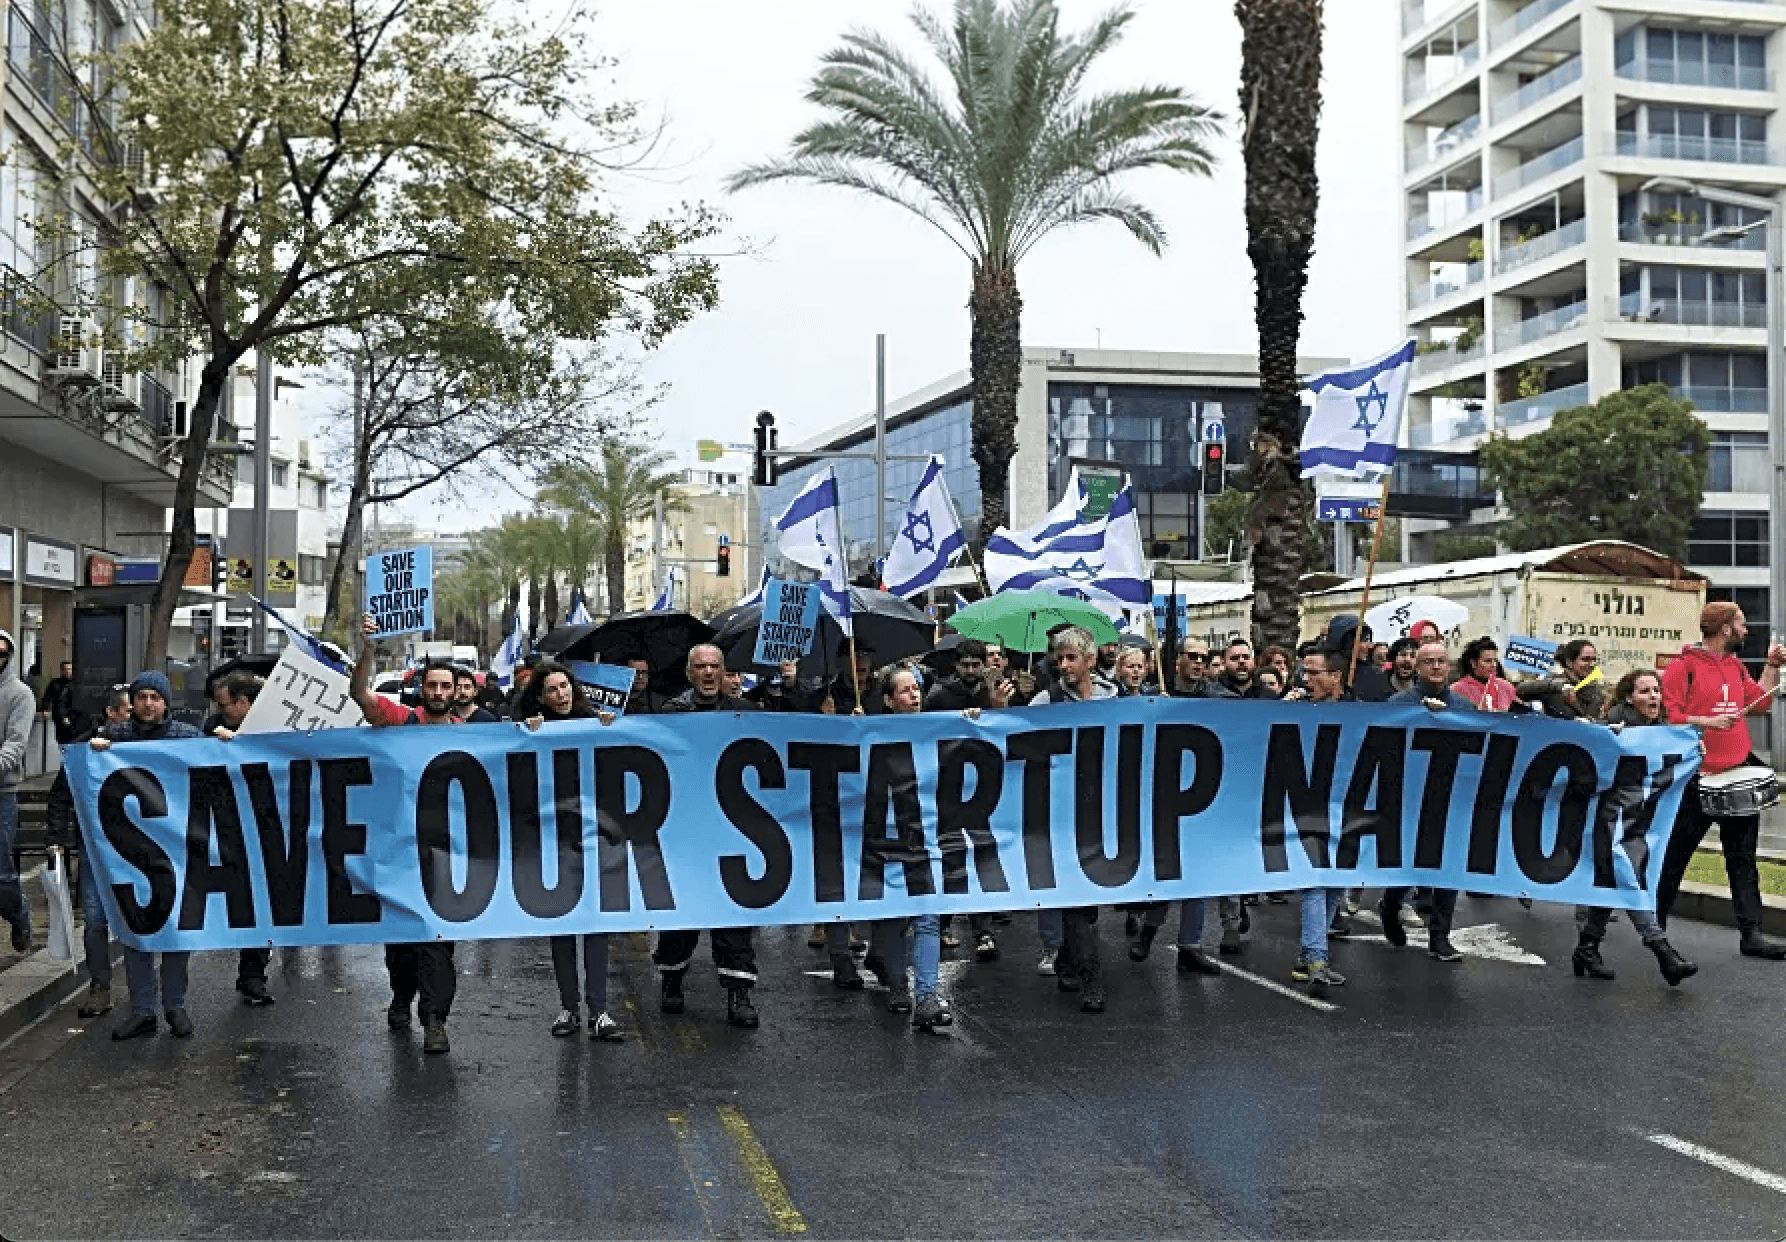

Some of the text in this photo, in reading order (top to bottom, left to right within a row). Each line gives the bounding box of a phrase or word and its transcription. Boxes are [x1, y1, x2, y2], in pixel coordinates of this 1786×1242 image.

[381, 551, 416, 574] SAVE
[385, 572, 413, 592] OUR
[369, 588, 429, 614] STARTUP
[780, 584, 808, 607] SAVE
[1594, 587, 1645, 616] גולני
[375, 609, 425, 634] NATION
[780, 605, 803, 624] OUR
[762, 621, 813, 644] STARTUP
[97, 723, 1683, 935] SAVE OUR STARTUP NATION
